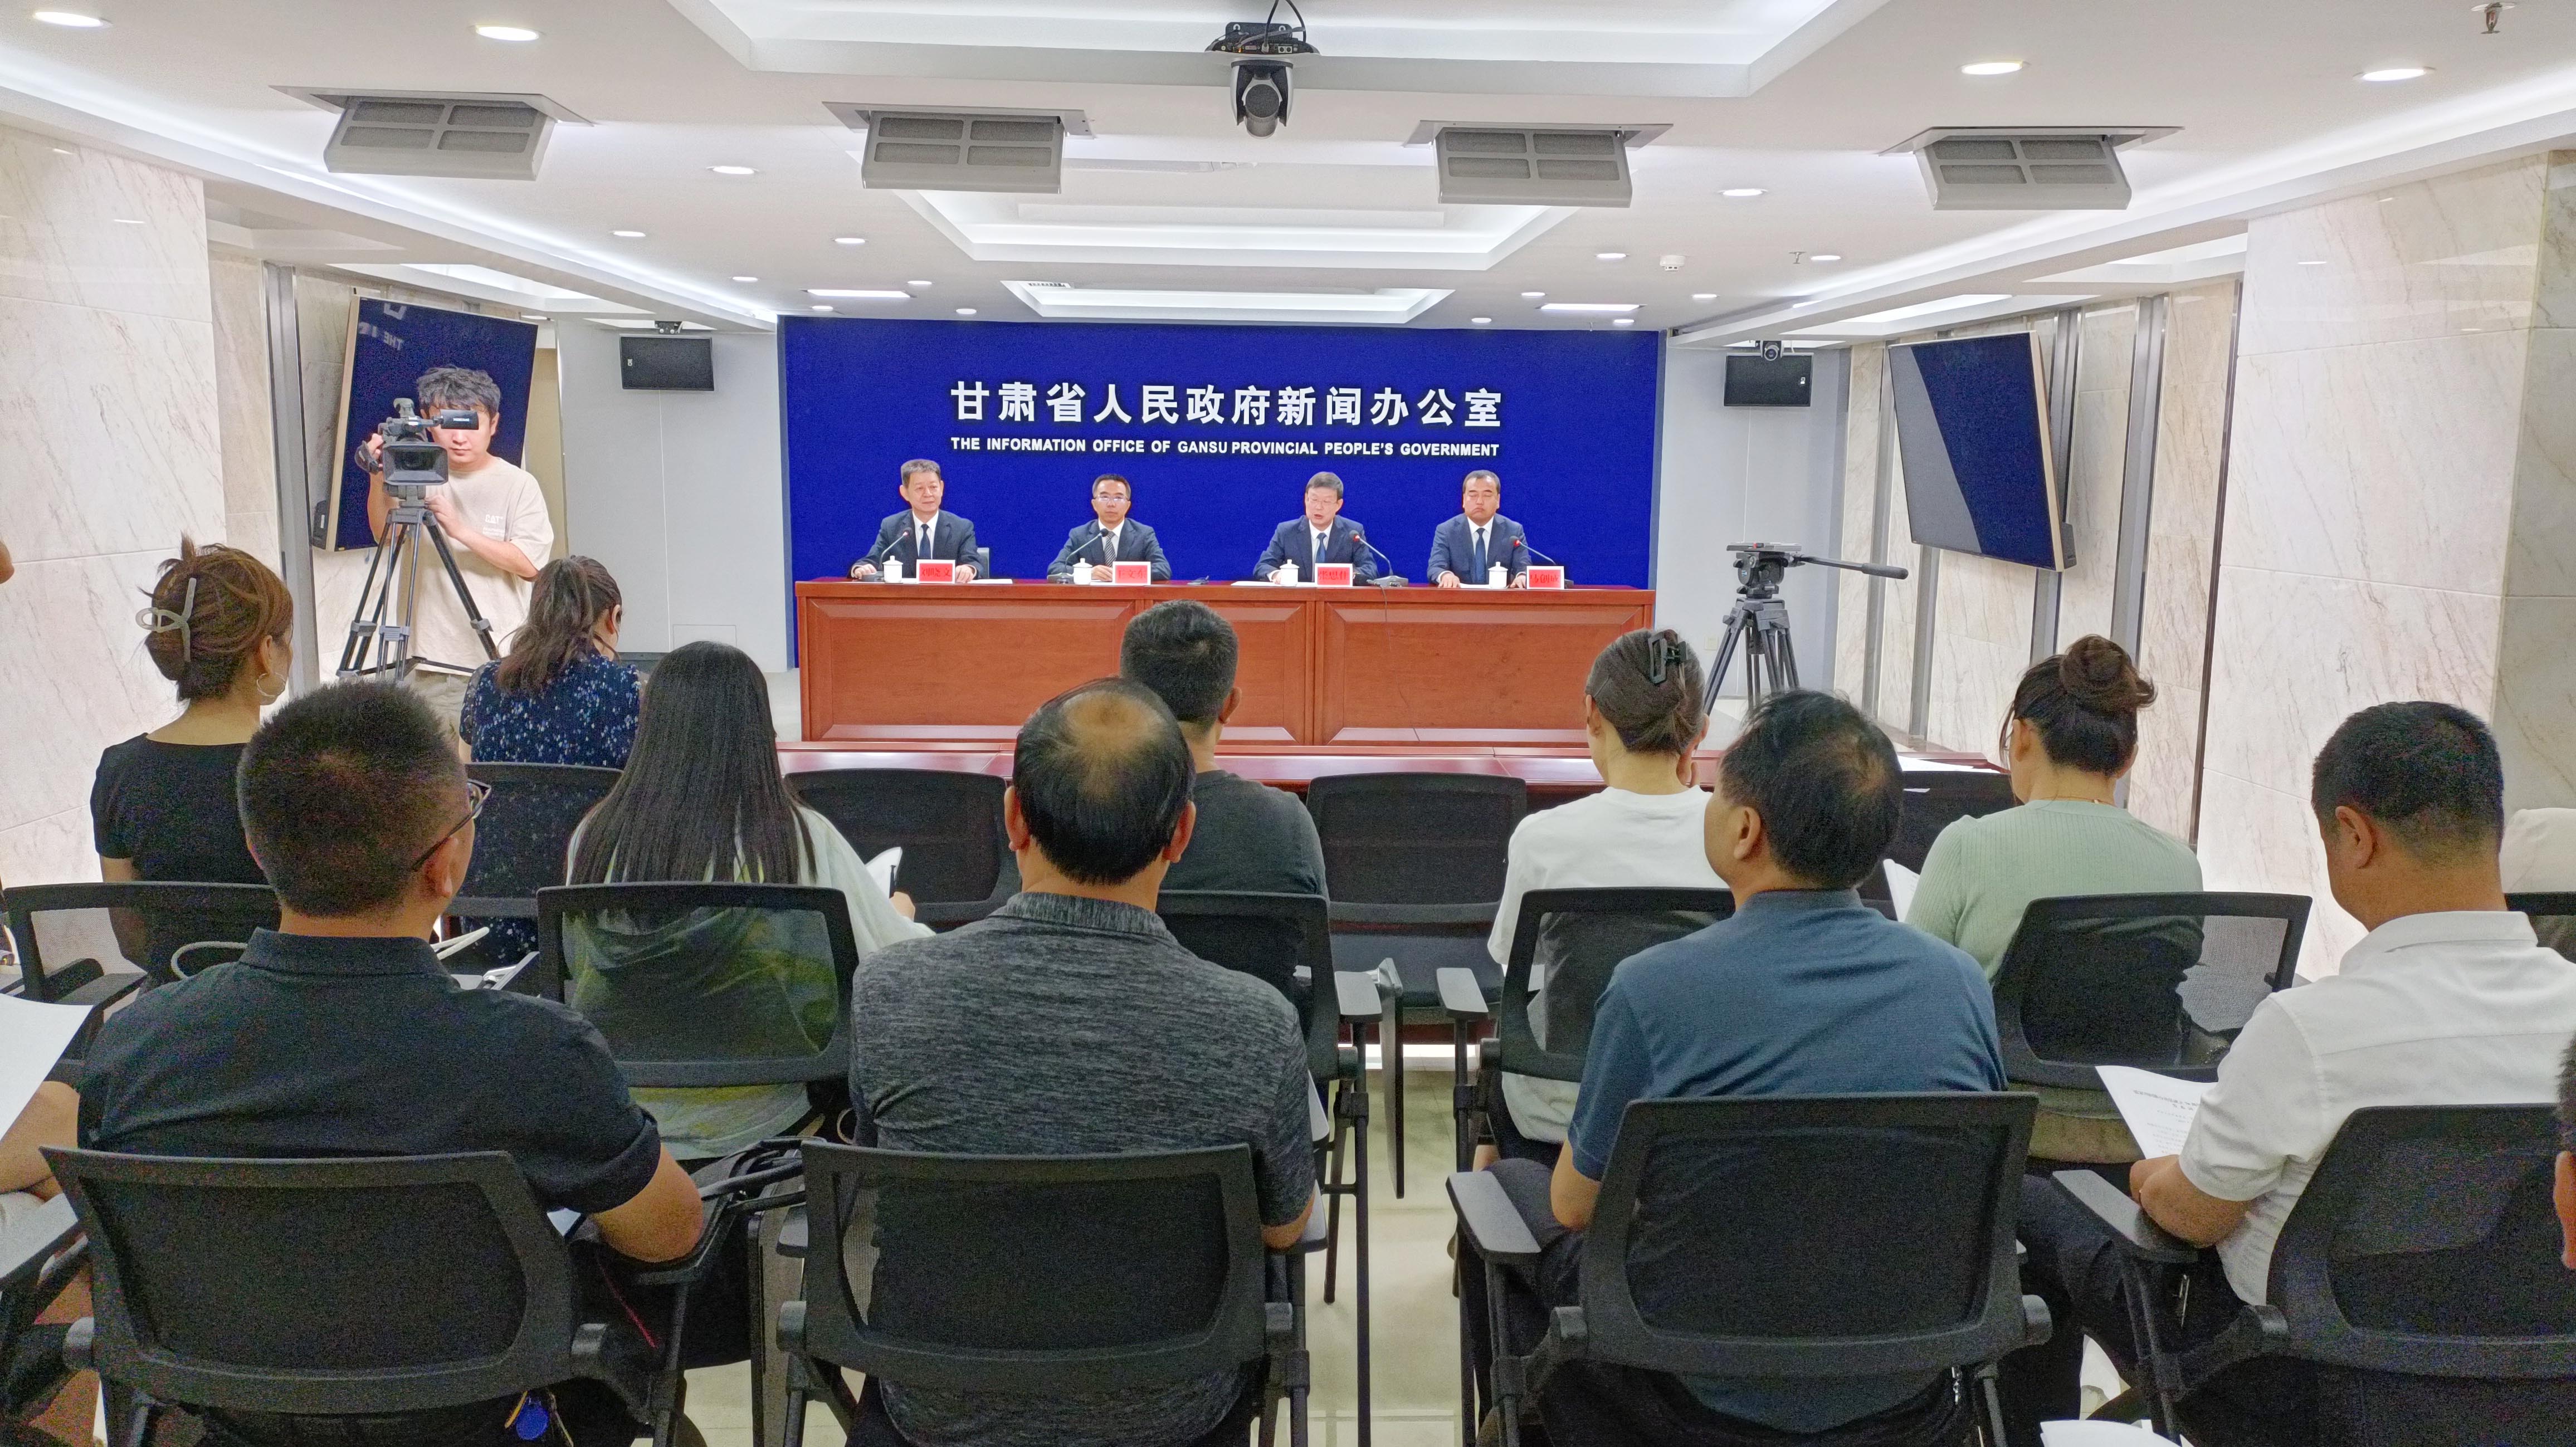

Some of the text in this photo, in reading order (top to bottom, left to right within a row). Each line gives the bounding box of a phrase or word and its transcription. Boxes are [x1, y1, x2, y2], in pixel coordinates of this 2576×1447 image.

[950, 380, 1501, 427] 甘肃省人民政府新闻办公室
[951, 437, 980, 449] THE
[987, 438, 1085, 451] INFORMATION
[1093, 439, 1144, 452] OFFICE
[1152, 441, 1170, 452] OF
[1178, 441, 1227, 453] GANSU
[1232, 442, 1318, 454] PROVINCIAL
[1401, 443, 1499, 456] GOVERNMENT
[485, 514, 499, 525] CAT
